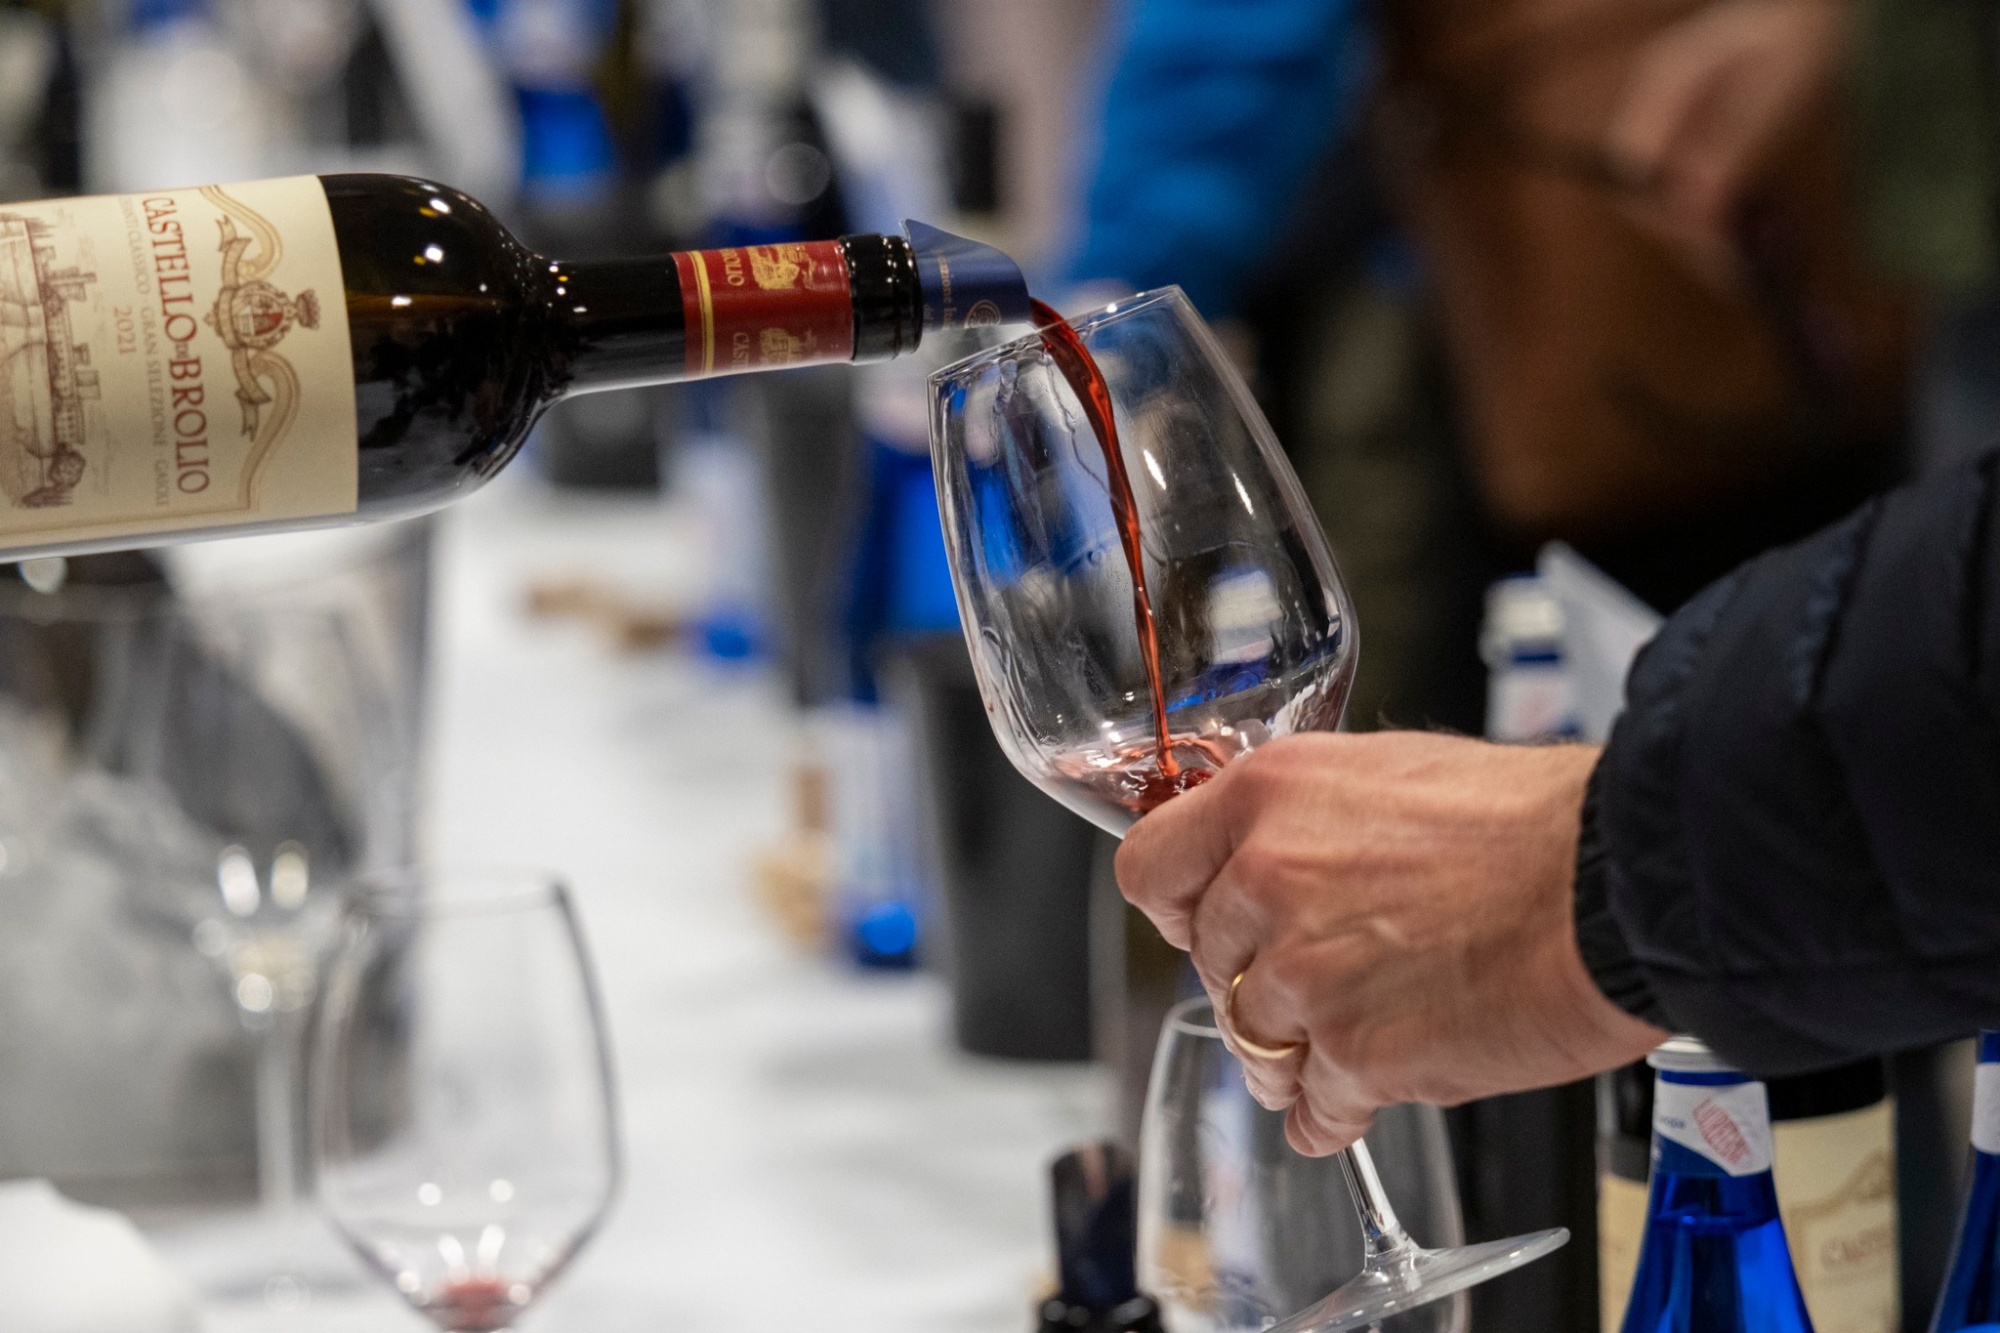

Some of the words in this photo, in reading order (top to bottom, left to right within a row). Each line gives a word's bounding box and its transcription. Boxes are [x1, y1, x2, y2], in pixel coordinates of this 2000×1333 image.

[113, 305, 137, 354] 2021
[128, 229, 151, 295] CLASSICO
[141, 305, 158, 354] GRAN
[142, 197, 198, 343] CASTELLO
[169, 354, 210, 494] BROLIO
